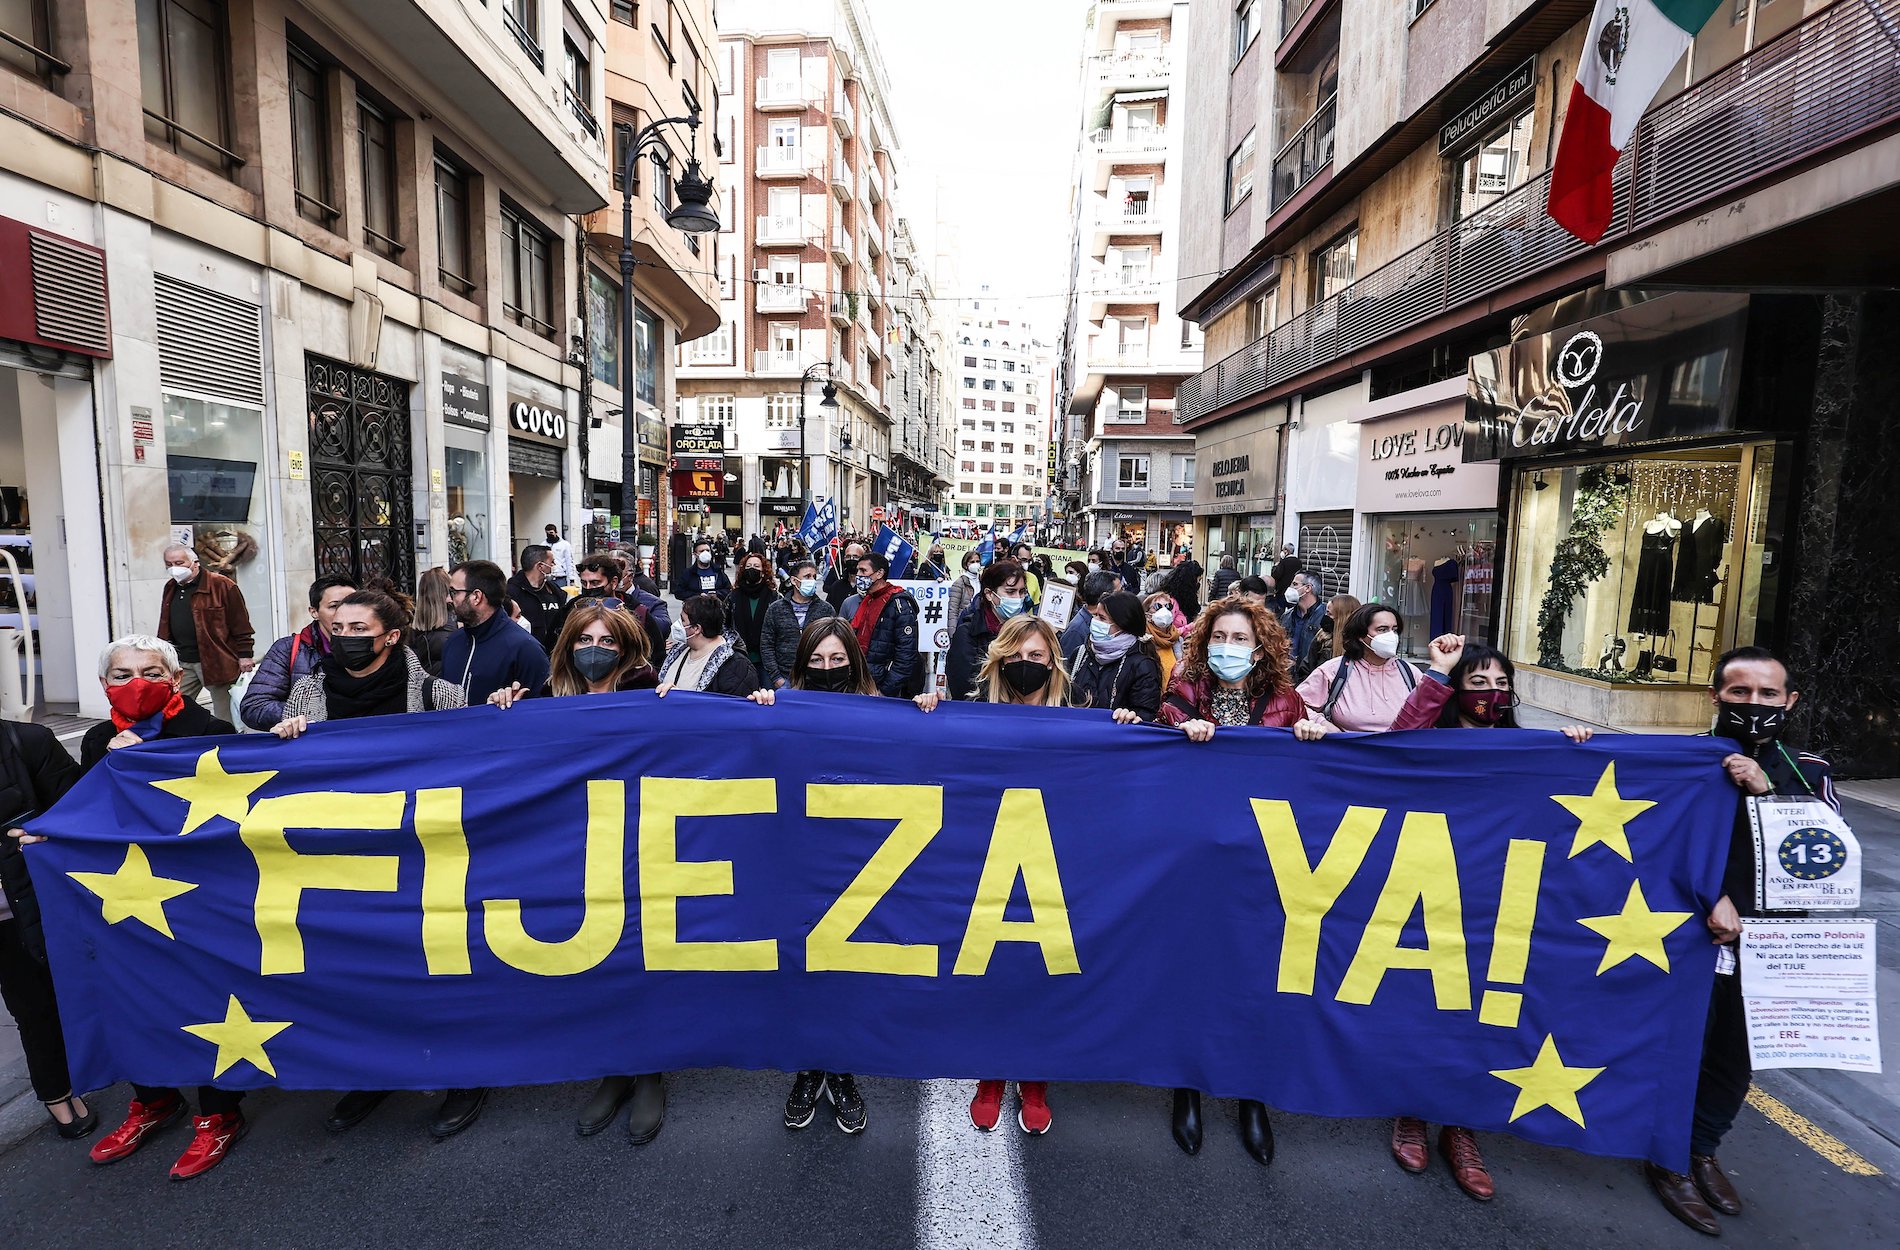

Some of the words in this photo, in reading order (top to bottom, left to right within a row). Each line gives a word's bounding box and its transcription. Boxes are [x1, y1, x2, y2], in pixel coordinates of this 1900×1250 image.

[1443, 86, 1506, 144] Peluquería
[1509, 70, 1527, 95] Emi
[516, 402, 565, 439] COCO
[1512, 384, 1645, 448] Carlota
[676, 440, 696, 448] ORO
[698, 440, 723, 449] PLATA
[1370, 430, 1417, 461] LOVE
[1424, 422, 1464, 452] LOV
[1048, 442, 1056, 486] HOTEL
[1213, 455, 1250, 477] RELOJERIA
[1385, 468, 1399, 480] 100%
[1429, 464, 1455, 478] España
[1215, 479, 1245, 497] TECNICA
[1395, 488, 1442, 498] www.lovelova.com
[1114, 511, 1134, 519] Etam
[939, 587, 951, 598] P
[1791, 843, 1832, 864] 13
[1769, 875, 1794, 883] AÑOS
[240, 777, 1081, 976] FIJEZA
[1250, 798, 1547, 1029] YA!
[1748, 931, 1788, 940] España,
[1824, 931, 1865, 939] Polonia
[1779, 1030, 1800, 1039] ERE
